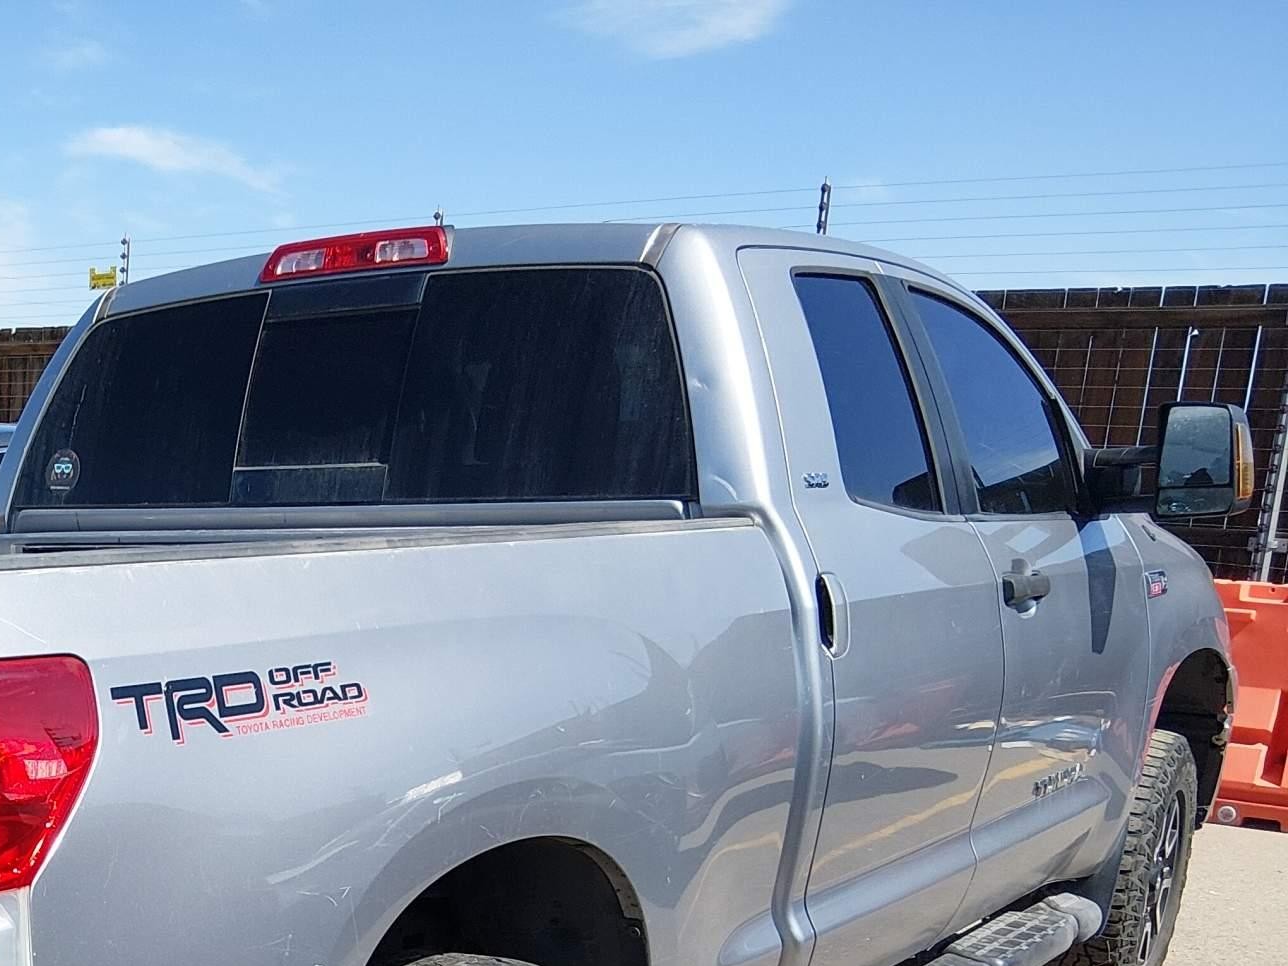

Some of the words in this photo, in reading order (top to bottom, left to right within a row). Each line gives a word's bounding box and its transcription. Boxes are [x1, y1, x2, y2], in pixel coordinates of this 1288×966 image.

[268, 661, 336, 689] OFF
[110, 670, 268, 745] TRD
[272, 682, 368, 714] ROAD
[235, 722, 270, 736] TOYOTA
[272, 714, 305, 730] RACING
[307, 706, 368, 724] DEVELOPMENT
